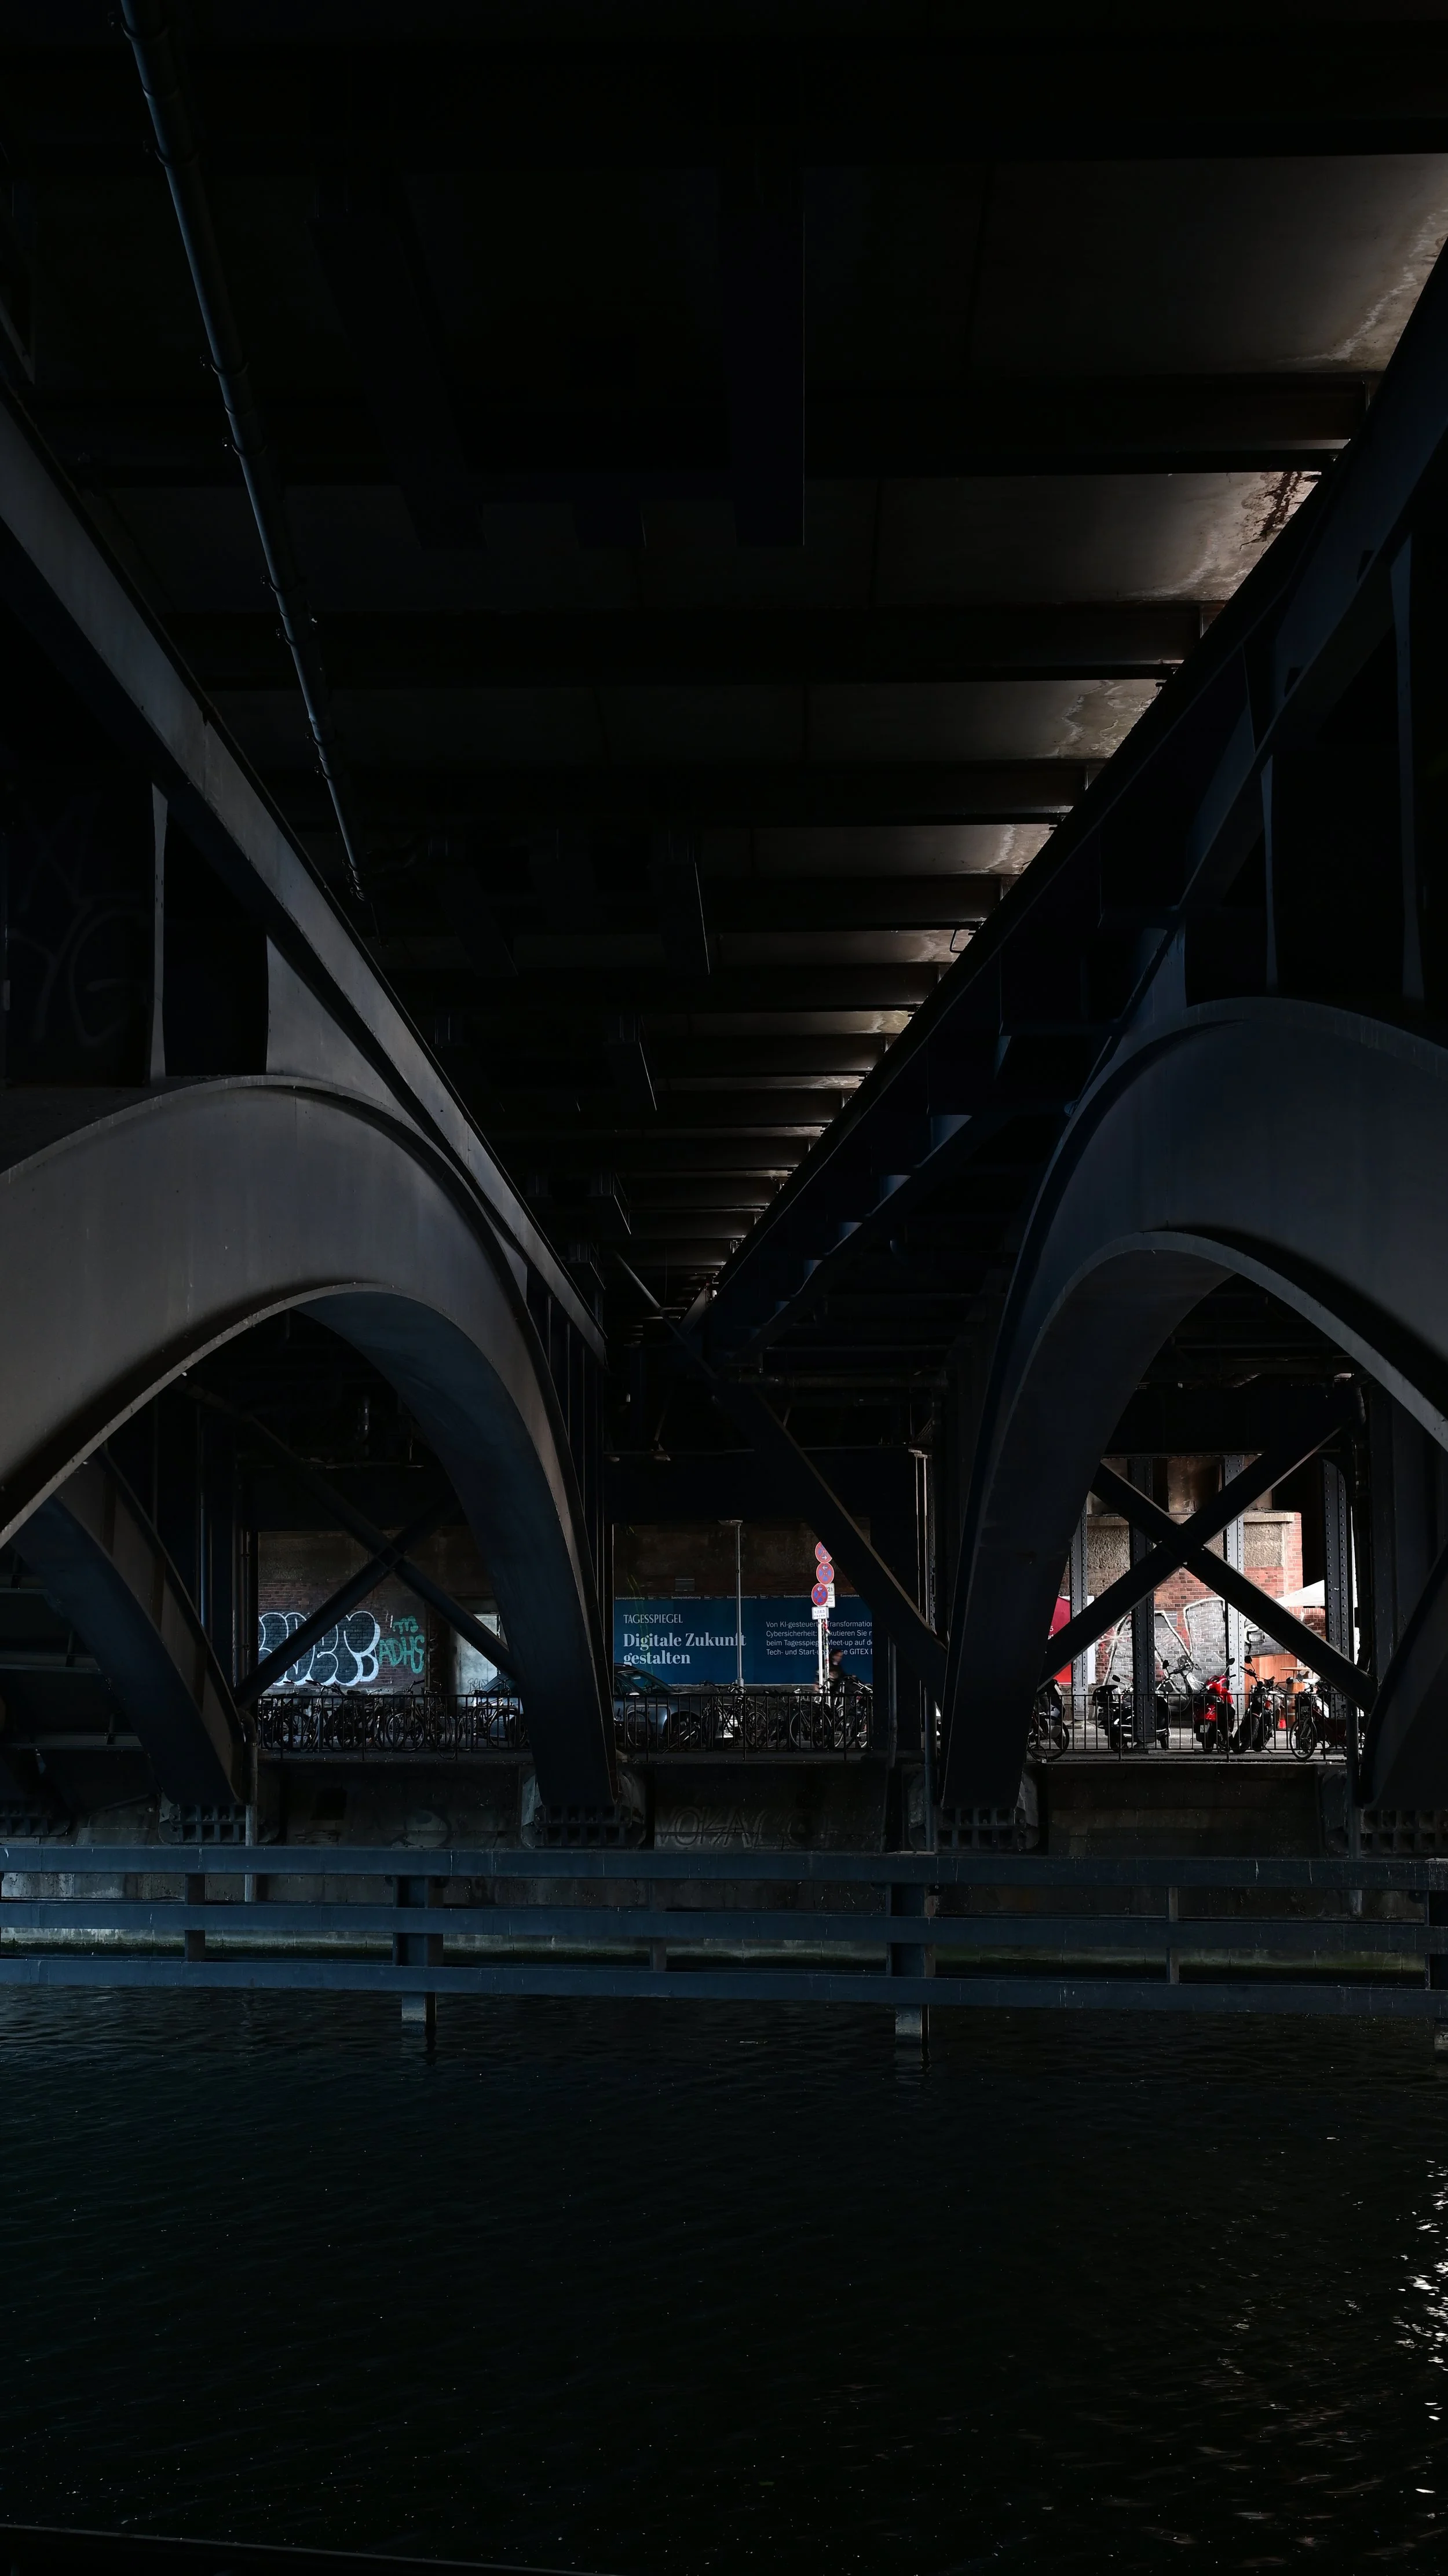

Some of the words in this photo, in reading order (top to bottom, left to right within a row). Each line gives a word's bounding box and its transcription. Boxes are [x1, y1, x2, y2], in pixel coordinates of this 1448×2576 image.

[623, 1614, 683, 1624] TAGESSPIEGEL
[623, 1632, 682, 1651] Digitale
[784, 1639, 819, 1647] Tagesspieg
[623, 1650, 691, 1667] gestalten
